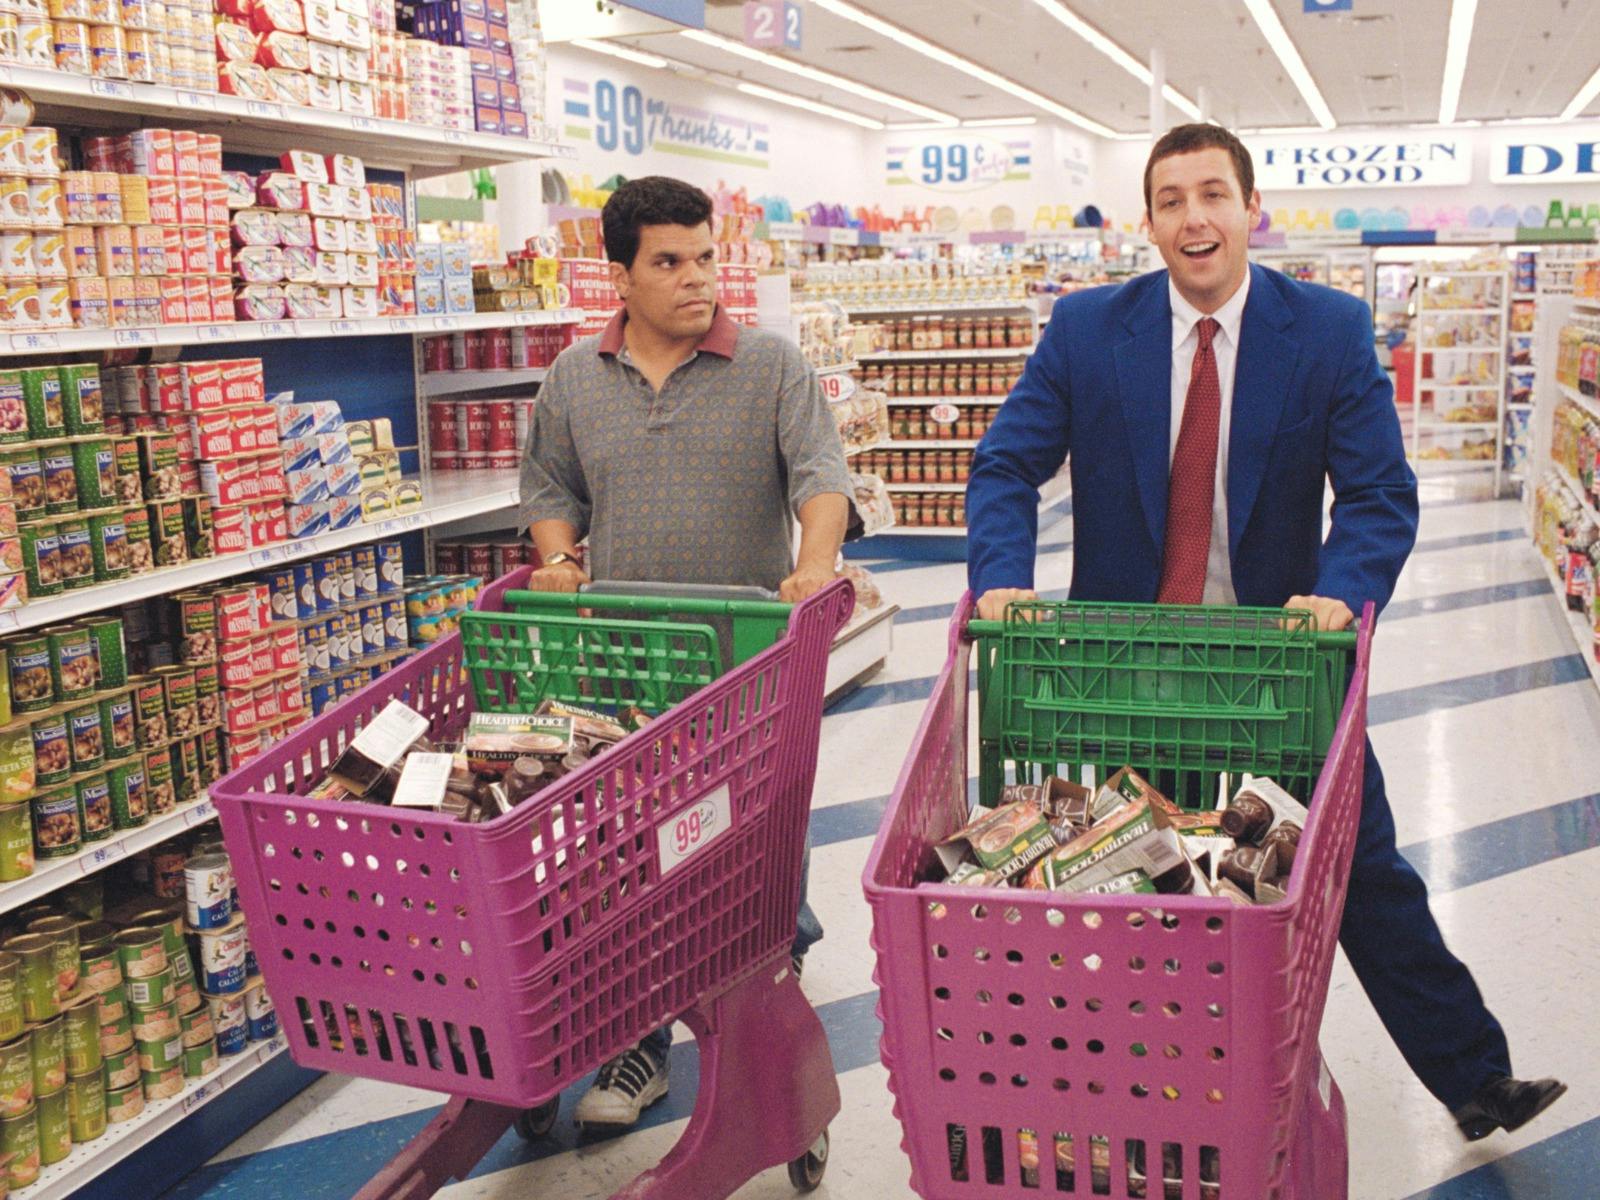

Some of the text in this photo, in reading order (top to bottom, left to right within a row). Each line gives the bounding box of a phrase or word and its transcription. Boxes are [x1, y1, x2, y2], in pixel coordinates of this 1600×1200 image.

[754, 6, 774, 38] 2
[787, 9, 798, 40] 2
[1264, 142, 1457, 165] FROZEN
[1296, 165, 1424, 185] FOOD
[475, 714, 566, 727] HEALTHY CHOICE
[675, 810, 701, 853] 99
